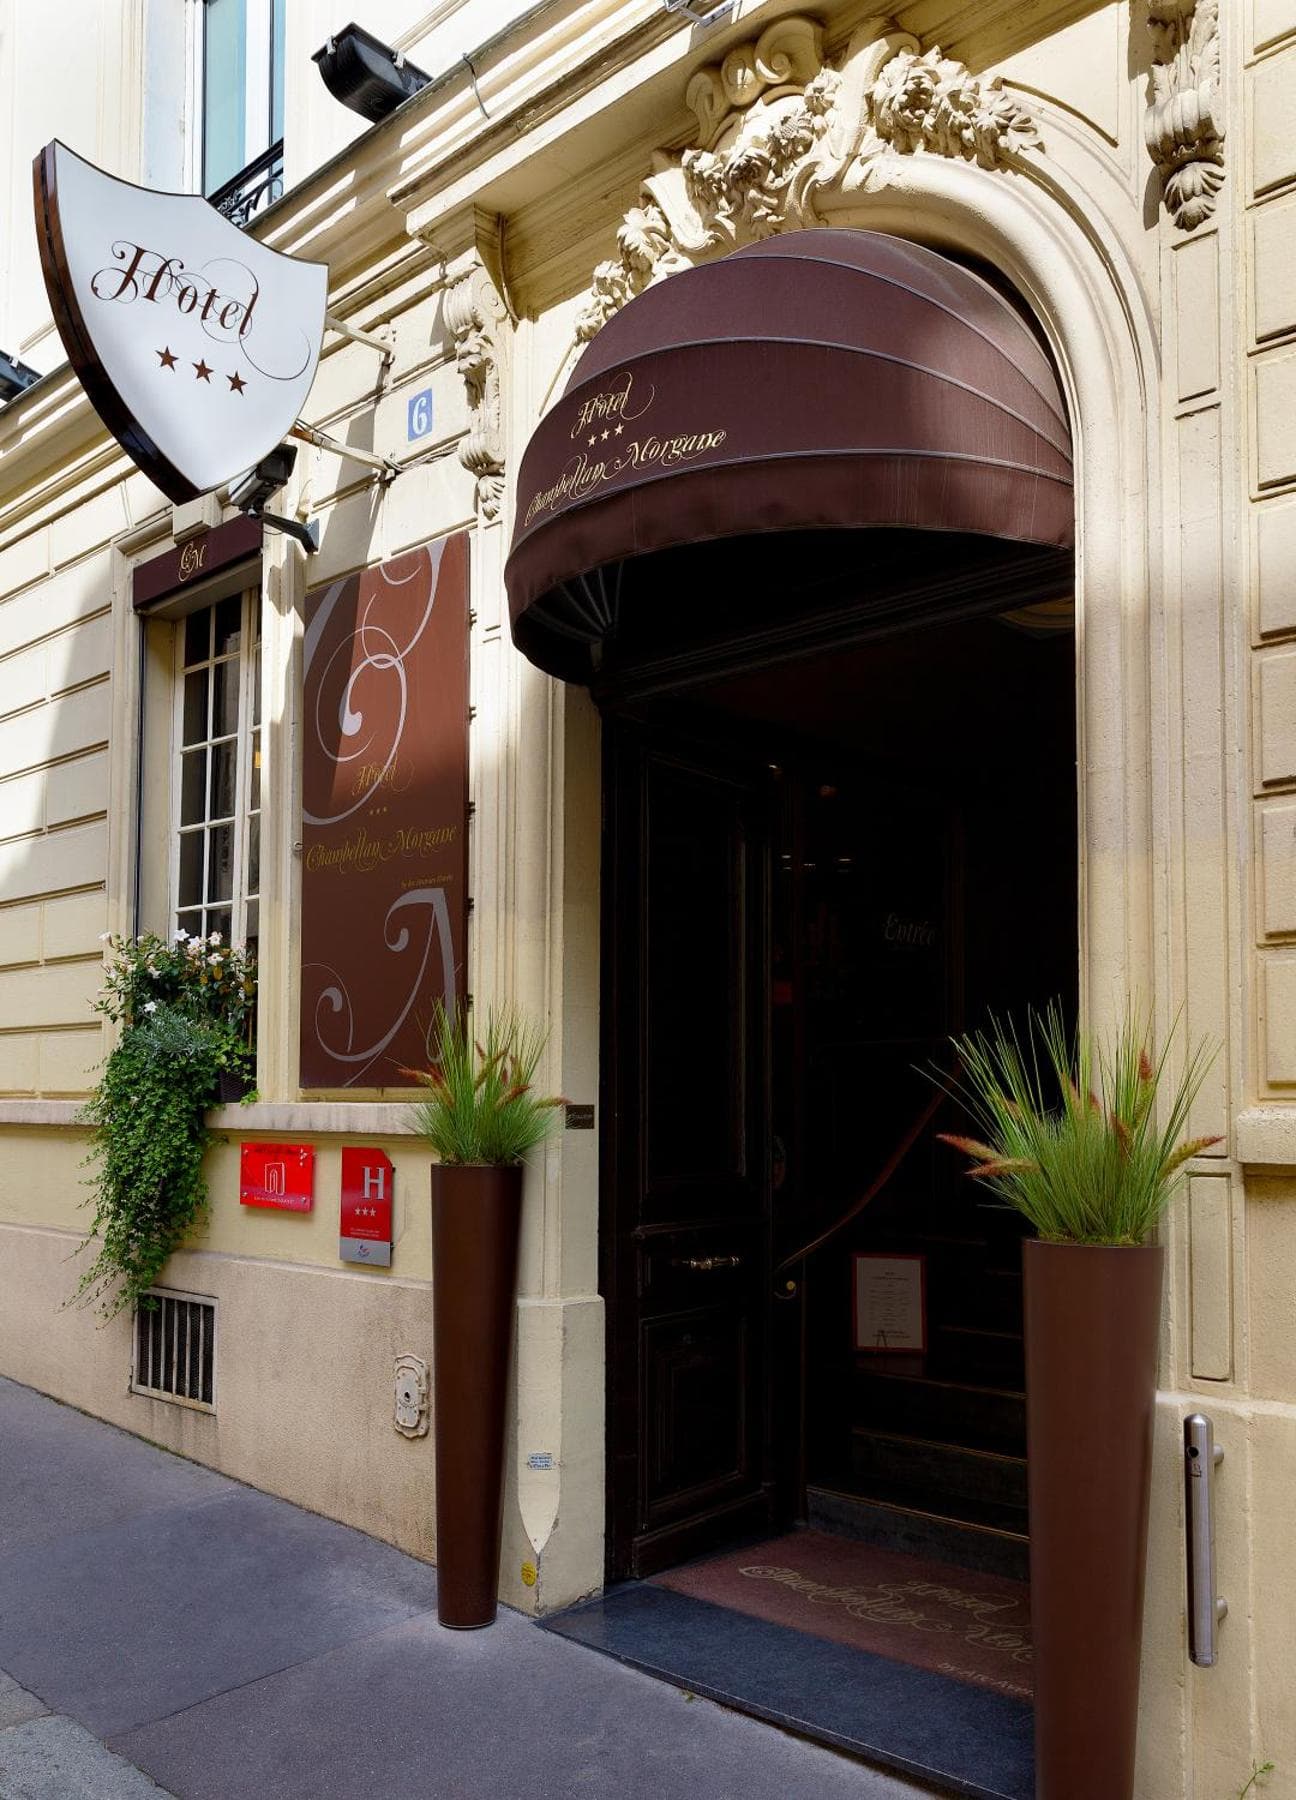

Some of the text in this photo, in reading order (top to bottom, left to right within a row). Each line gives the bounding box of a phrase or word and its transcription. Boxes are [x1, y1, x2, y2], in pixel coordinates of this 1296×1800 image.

[90, 240, 311, 381] Hotel
[412, 396, 428, 435] 6
[626, 429, 727, 470] Morgane
[394, 824, 457, 858] Morgane
[362, 1167, 385, 1200] H
